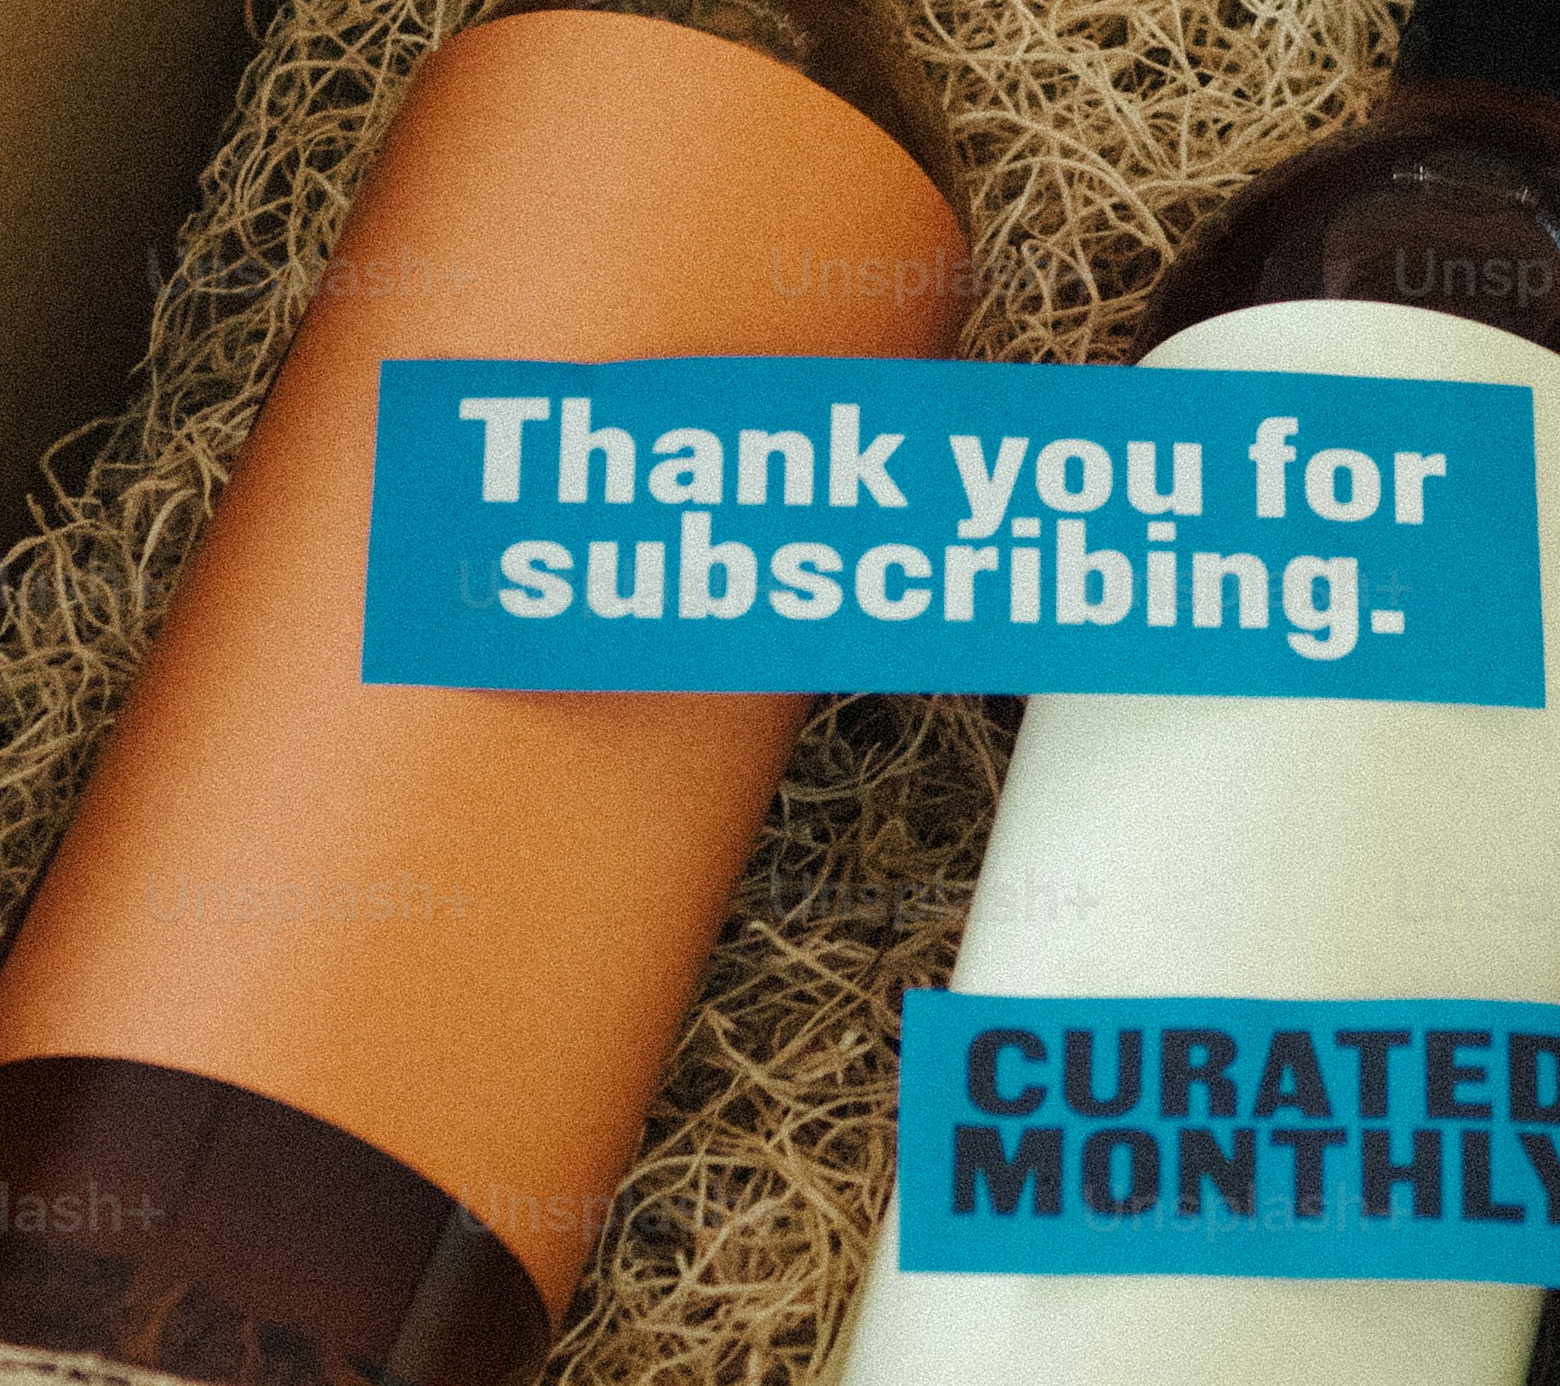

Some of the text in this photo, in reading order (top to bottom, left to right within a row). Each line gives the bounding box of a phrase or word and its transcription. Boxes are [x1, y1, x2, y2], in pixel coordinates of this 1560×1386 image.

[458, 396, 1448, 541] Thank you for
[498, 510, 1407, 662] subscribing.
